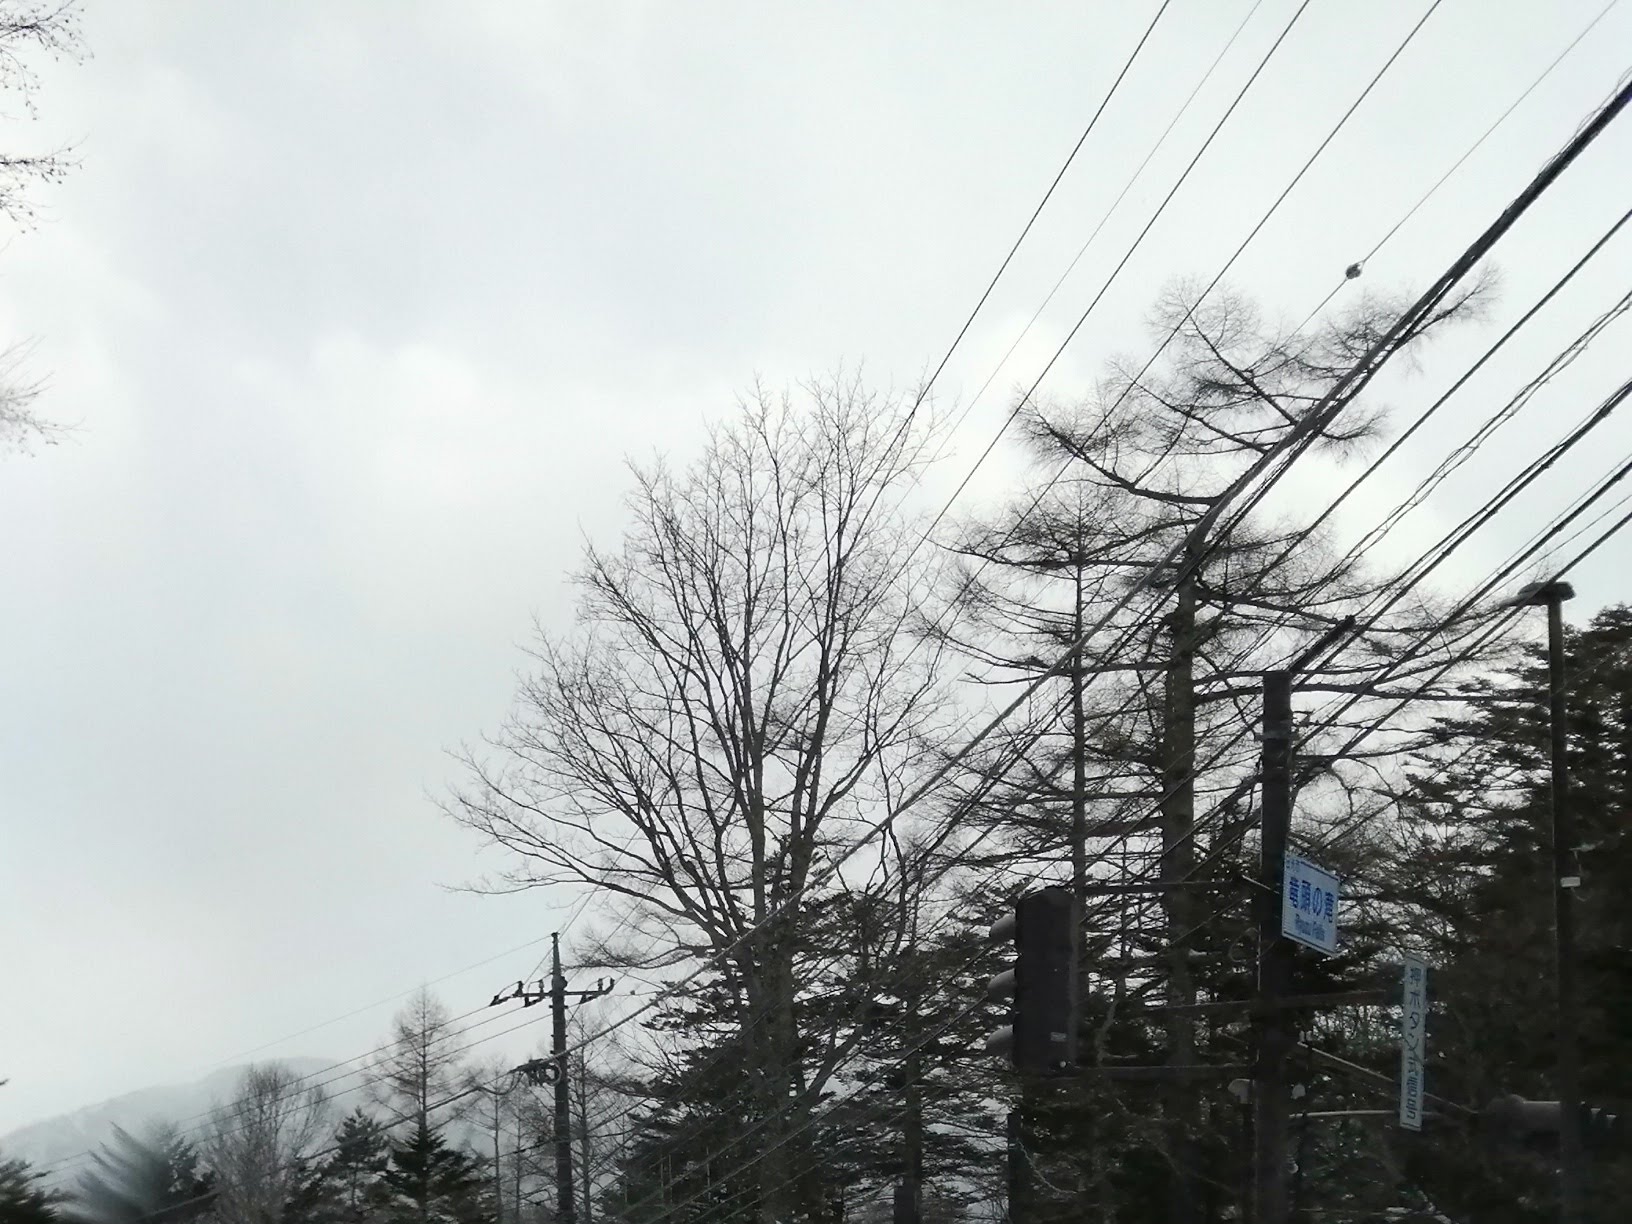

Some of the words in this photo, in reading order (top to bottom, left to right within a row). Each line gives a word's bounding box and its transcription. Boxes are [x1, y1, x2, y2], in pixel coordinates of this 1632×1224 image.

[1405, 966, 1422, 1121] 押ボタン式信号
